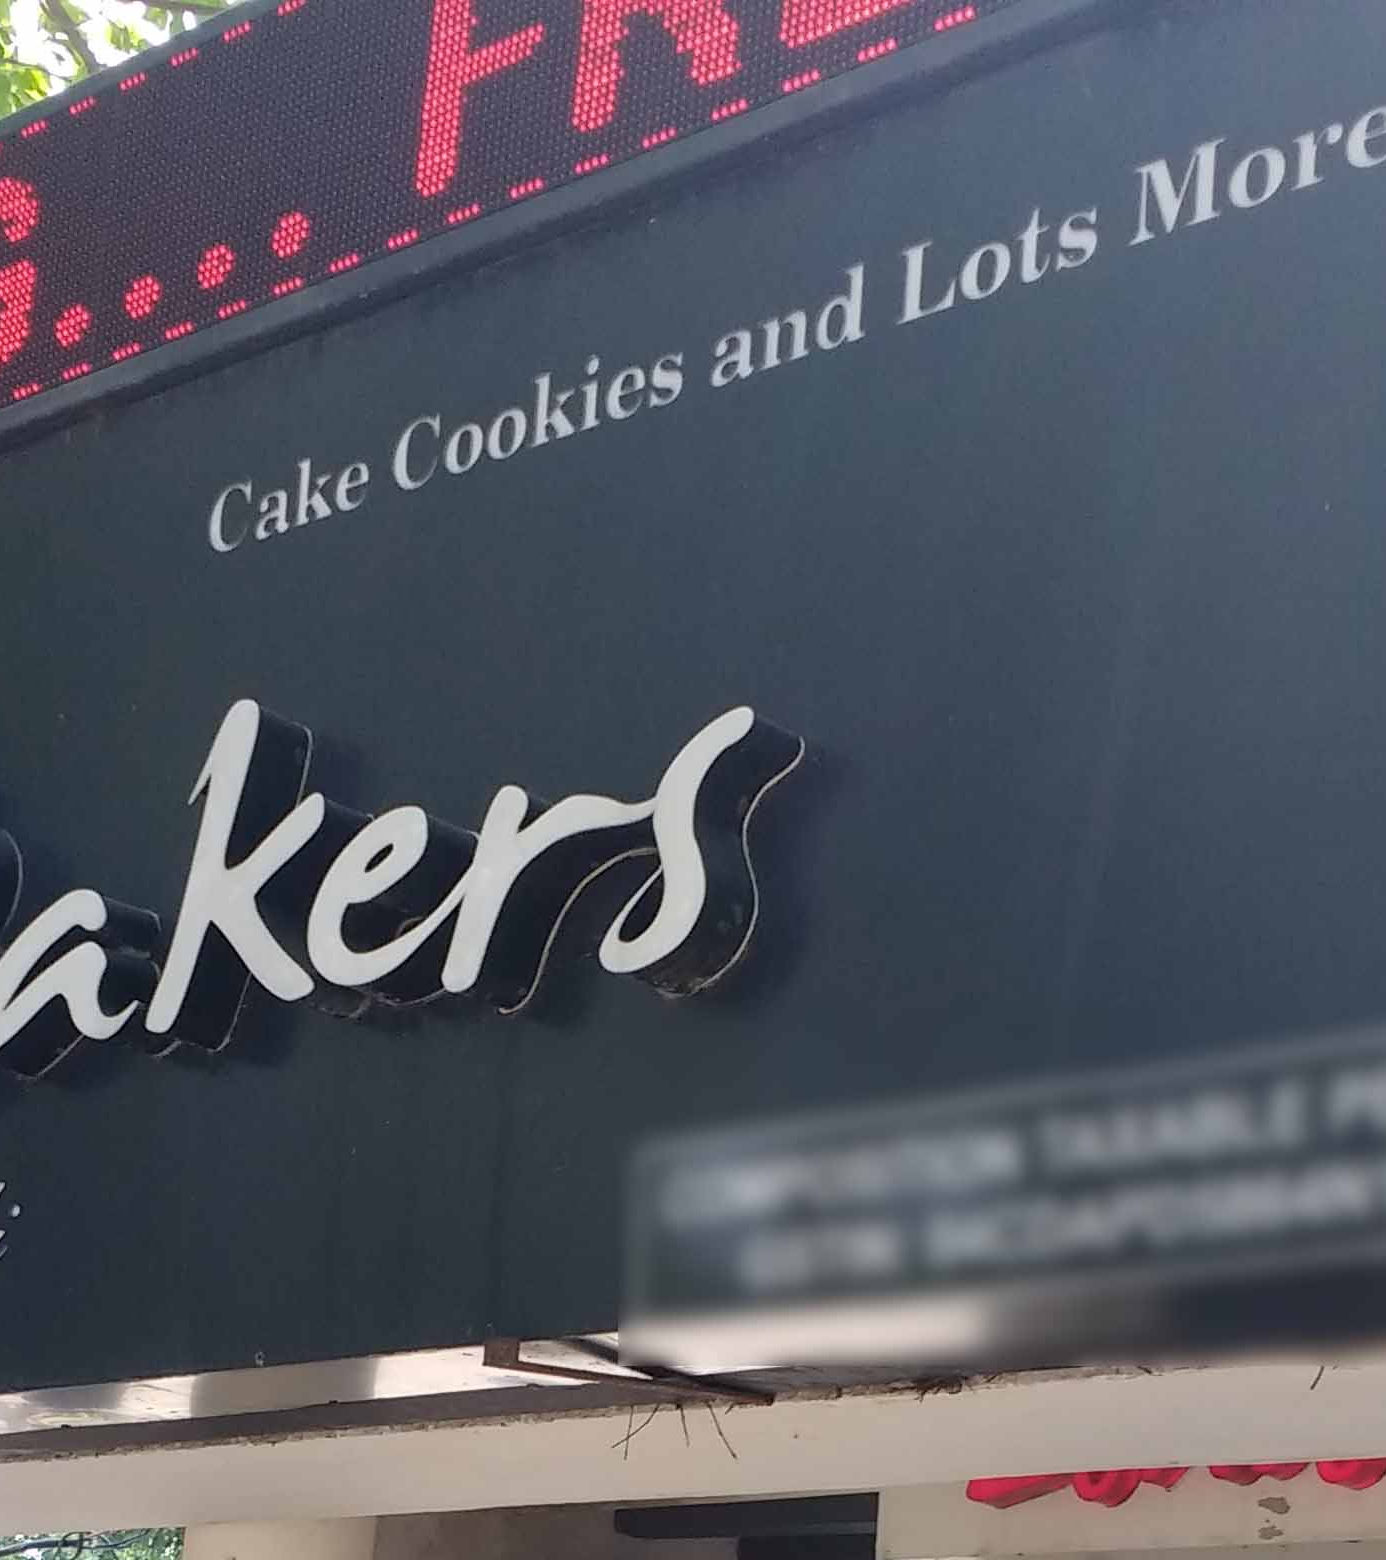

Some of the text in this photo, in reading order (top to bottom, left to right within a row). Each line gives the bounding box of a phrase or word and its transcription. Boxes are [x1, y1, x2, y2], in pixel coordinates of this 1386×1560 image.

[208, 461, 371, 554] Cake
[391, 350, 685, 494] Cookies
[709, 264, 865, 390] and
[897, 204, 1100, 328] Lots
